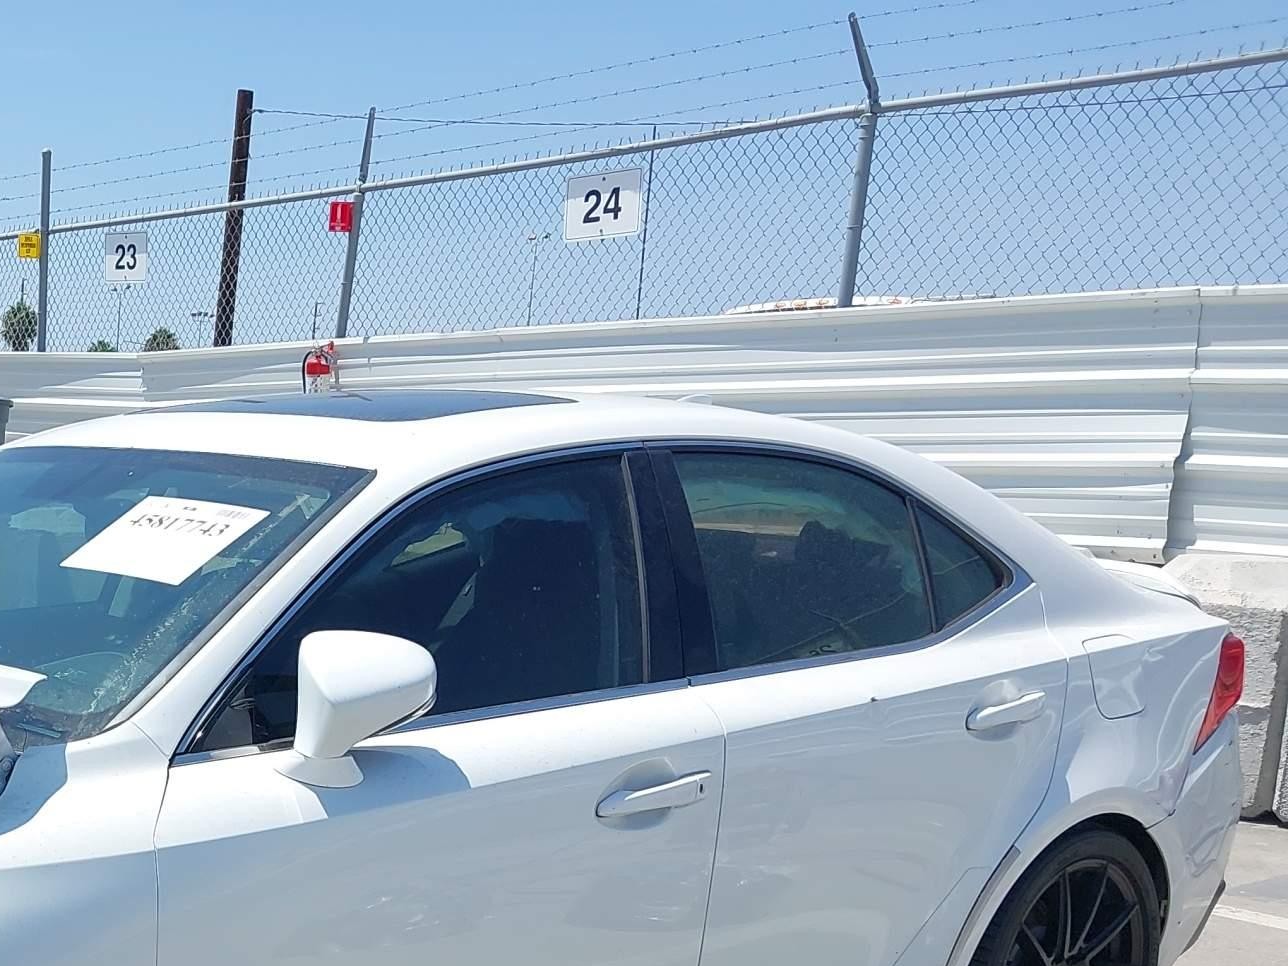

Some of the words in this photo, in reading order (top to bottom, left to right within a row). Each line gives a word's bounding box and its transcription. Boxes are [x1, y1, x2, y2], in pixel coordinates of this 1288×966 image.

[583, 186, 621, 224] 24
[115, 243, 137, 270] 23
[130, 513, 230, 536] 45817743
